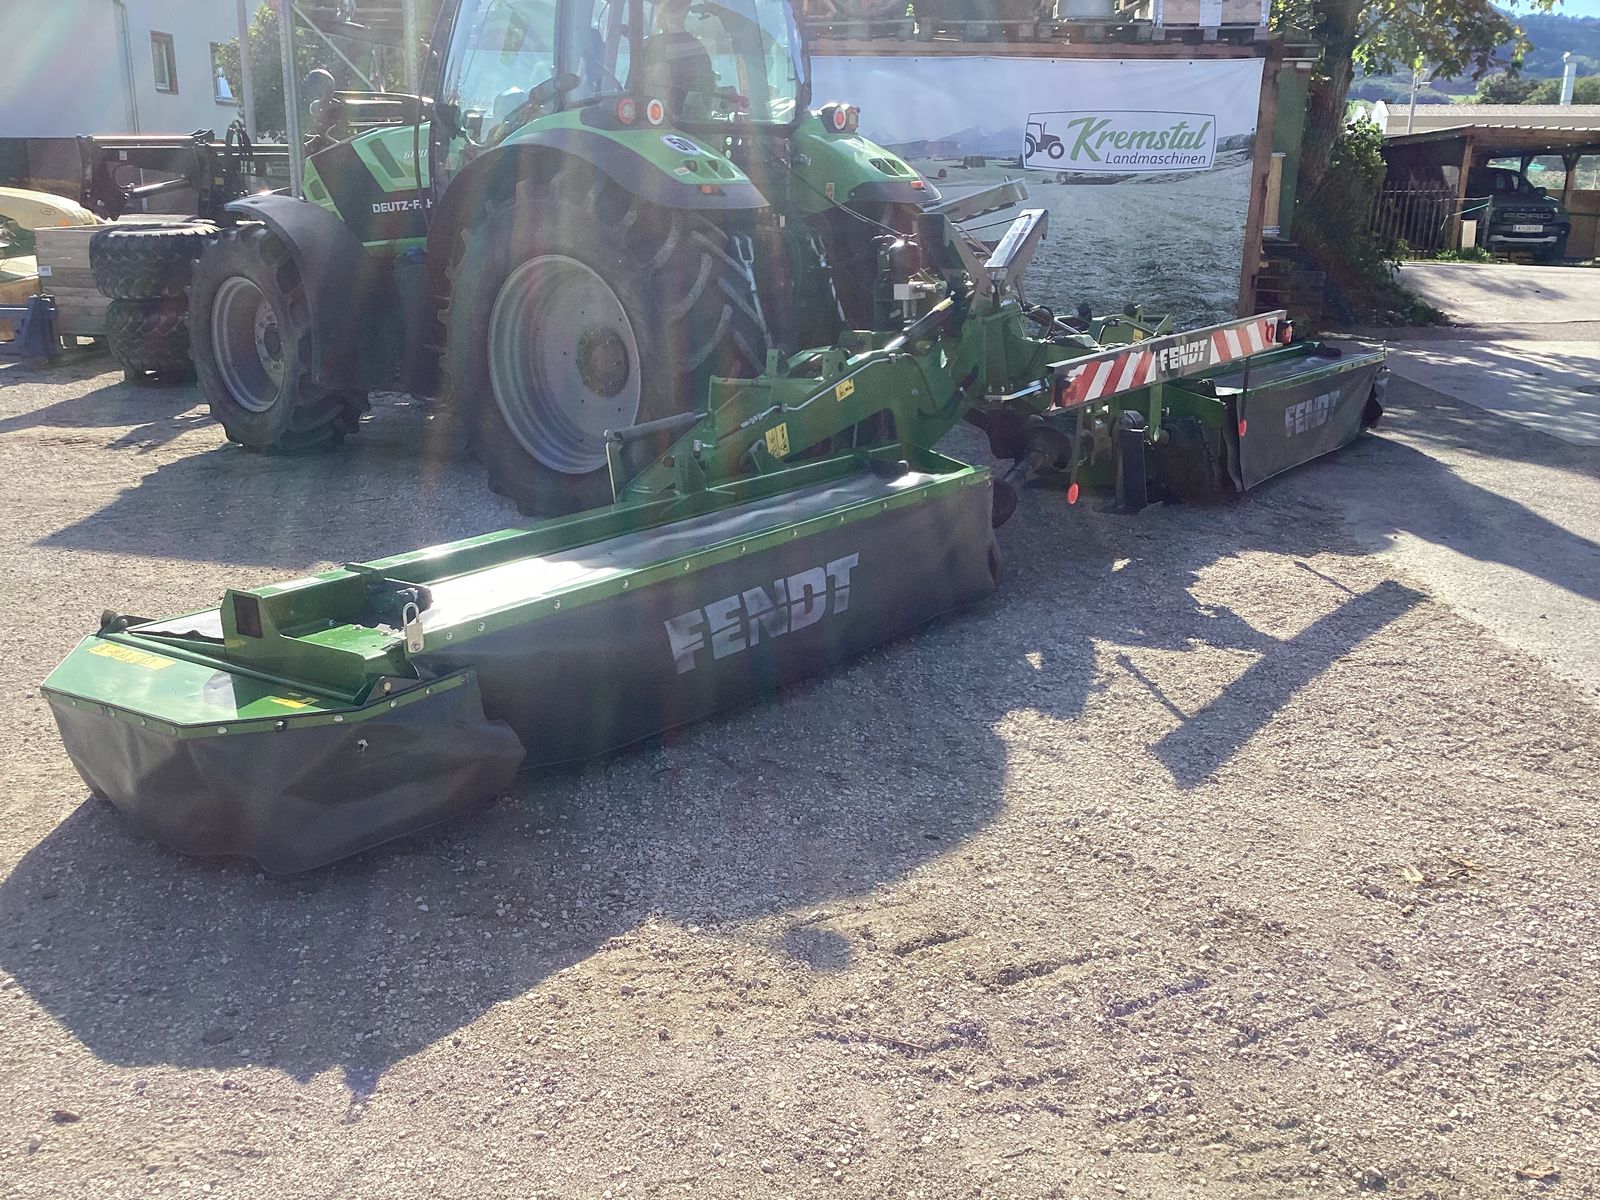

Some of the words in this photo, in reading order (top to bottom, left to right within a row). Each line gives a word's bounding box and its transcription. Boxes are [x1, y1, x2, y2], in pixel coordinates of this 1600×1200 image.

[665, 137, 698, 151] 50
[1067, 116, 1212, 162] Kremstal
[1105, 151, 1206, 165] Landmaschinen
[1160, 339, 1208, 371] FENDT
[1285, 390, 1340, 438] FENDT
[664, 552, 859, 675] FENDT
